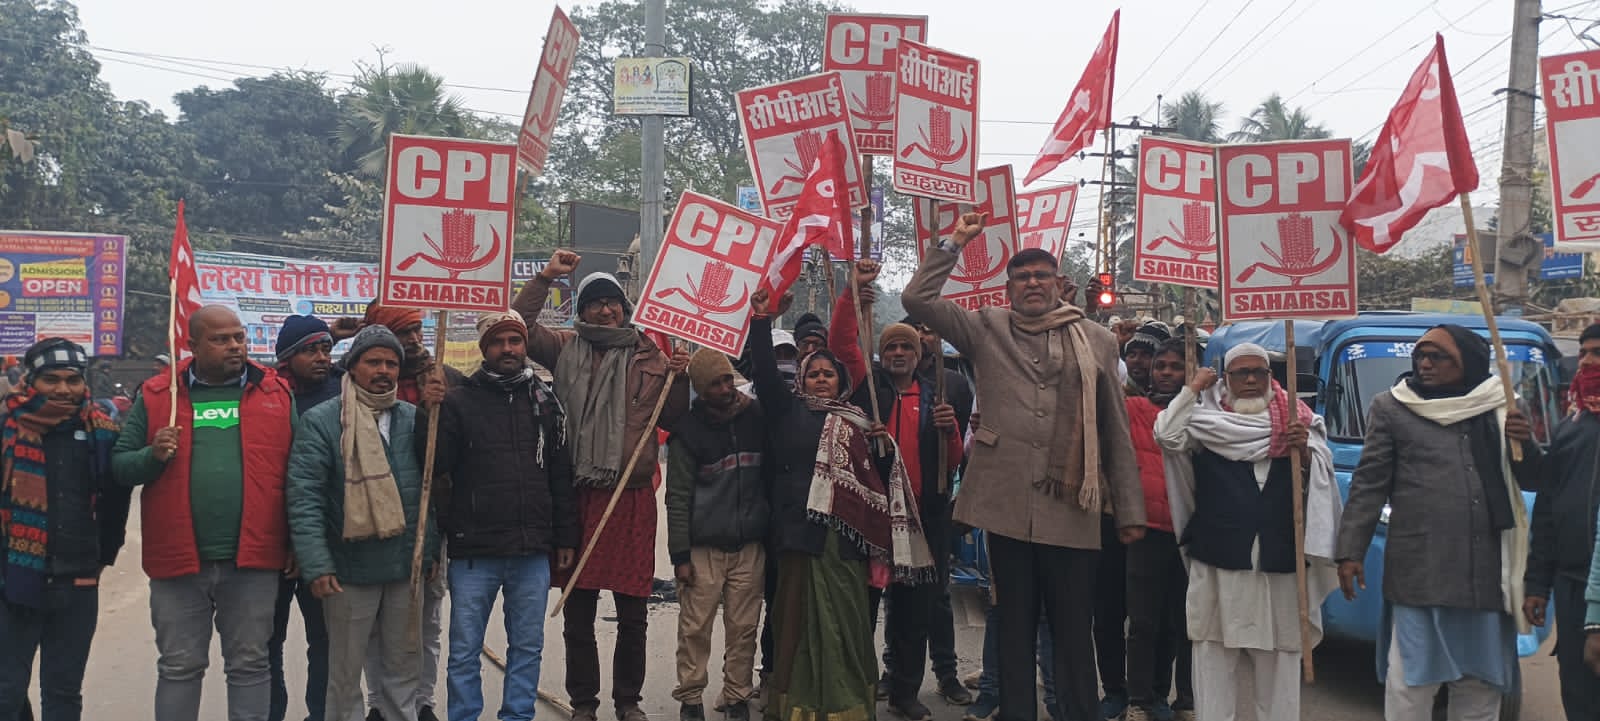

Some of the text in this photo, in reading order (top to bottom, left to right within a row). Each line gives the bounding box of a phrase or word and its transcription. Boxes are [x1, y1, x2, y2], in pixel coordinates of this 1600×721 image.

[900, 47, 975, 105] सीपीआई
[745, 77, 842, 130] सीपीआई
[396, 146, 510, 204] CPI
[900, 171, 968, 196] सहरसा
[1145, 146, 1214, 194] CP
[1226, 150, 1346, 208] CPI
[675, 202, 777, 268] CPI
[22, 266, 85, 276] ADMISSIONS
[26, 280, 82, 293] OPEN
[355, 266, 379, 298] सें
[1143, 259, 1218, 282] SAHARS
[346, 303, 369, 314] LIB
[392, 282, 501, 305] SAHARSA
[1234, 291, 1348, 312] SAHARSA
[645, 305, 736, 348] SAHARSA
